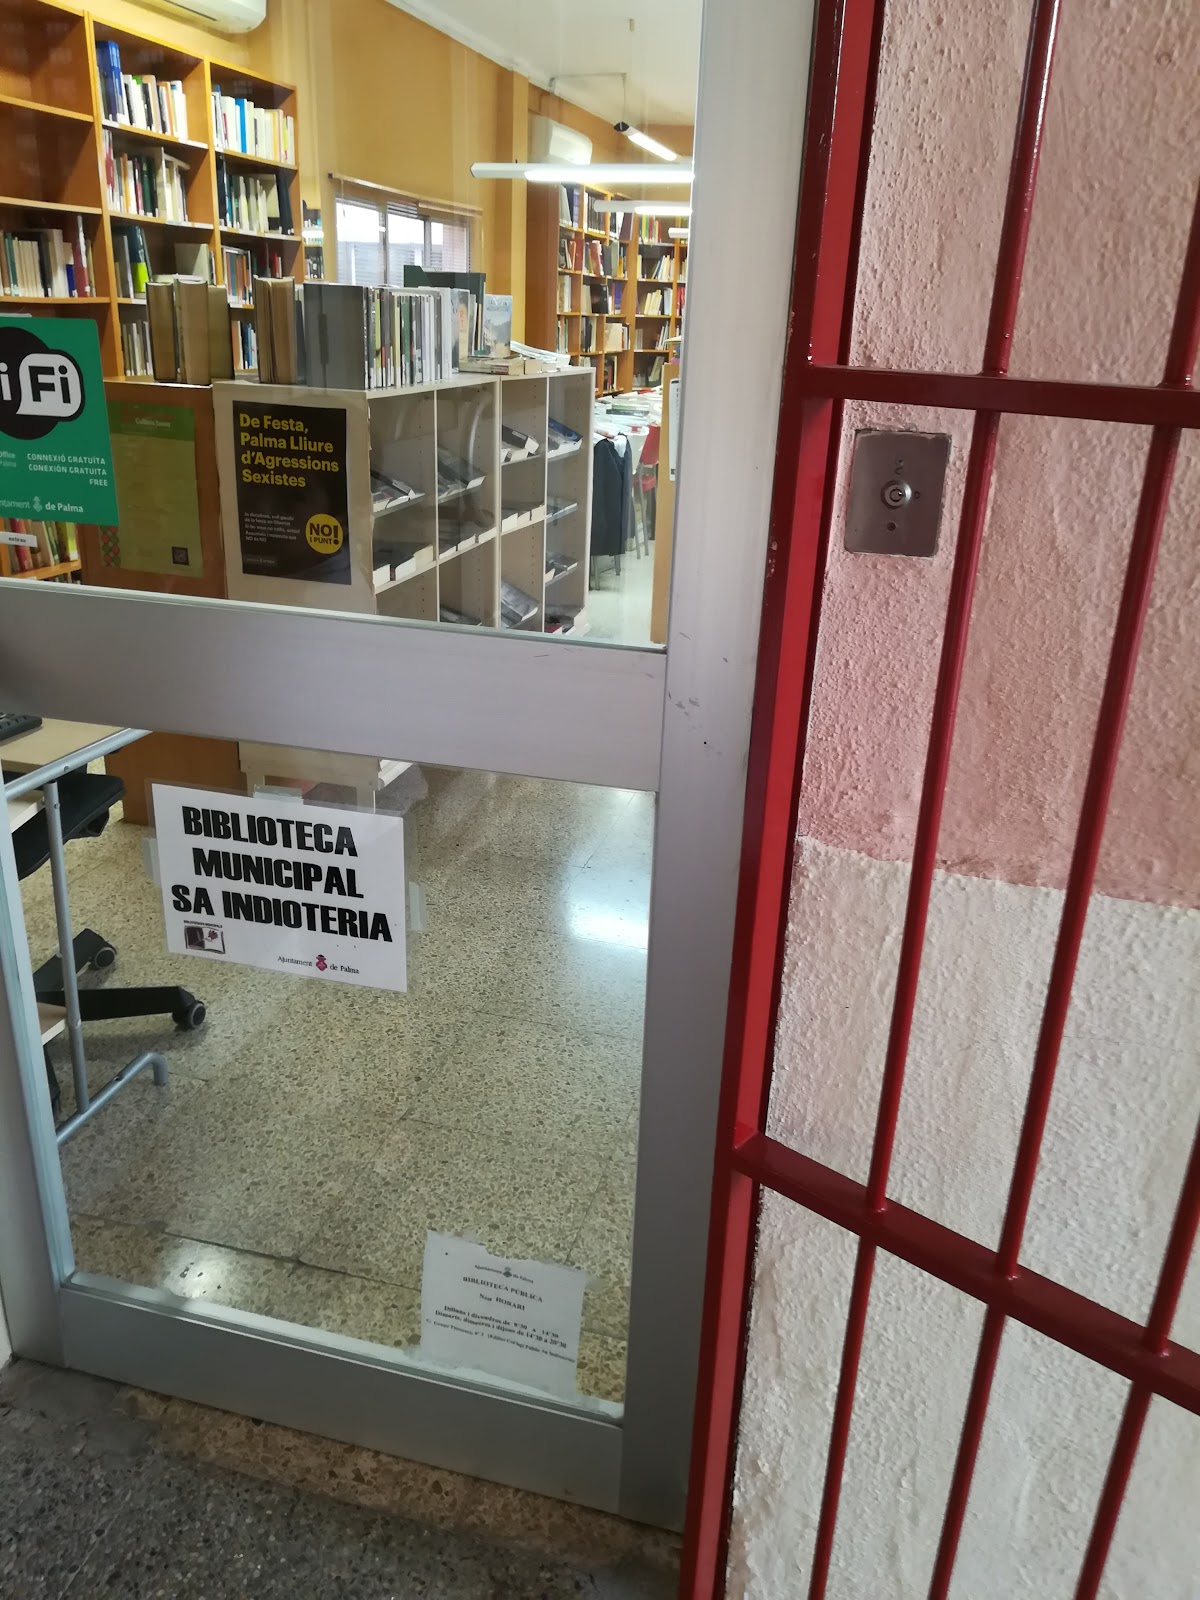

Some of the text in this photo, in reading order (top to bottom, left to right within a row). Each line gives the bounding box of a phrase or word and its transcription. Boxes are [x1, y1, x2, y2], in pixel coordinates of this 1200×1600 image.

[240, 413, 309, 434] De Festa,
[240, 432, 334, 453] Palma Lliure
[27, 453, 66, 463] CONNEXIÓ
[28, 464, 107, 476] CONEXIÓN GRATUITA
[242, 469, 306, 488] Sexistes
[89, 478, 108, 487] FREE
[45, 502, 56, 511] de
[57, 502, 84, 513] Palma
[310, 522, 340, 545] NO!
[314, 537, 332, 545] PUNT
[182, 806, 358, 857] BIBLIOTECA
[192, 848, 364, 899] MUNICIPAL
[171, 884, 393, 942] SA INDIOTERIA
[278, 956, 313, 967] Ajuntament
[340, 965, 360, 975] Palma
[463, 1276, 509, 1291] BIBLIOTECA
